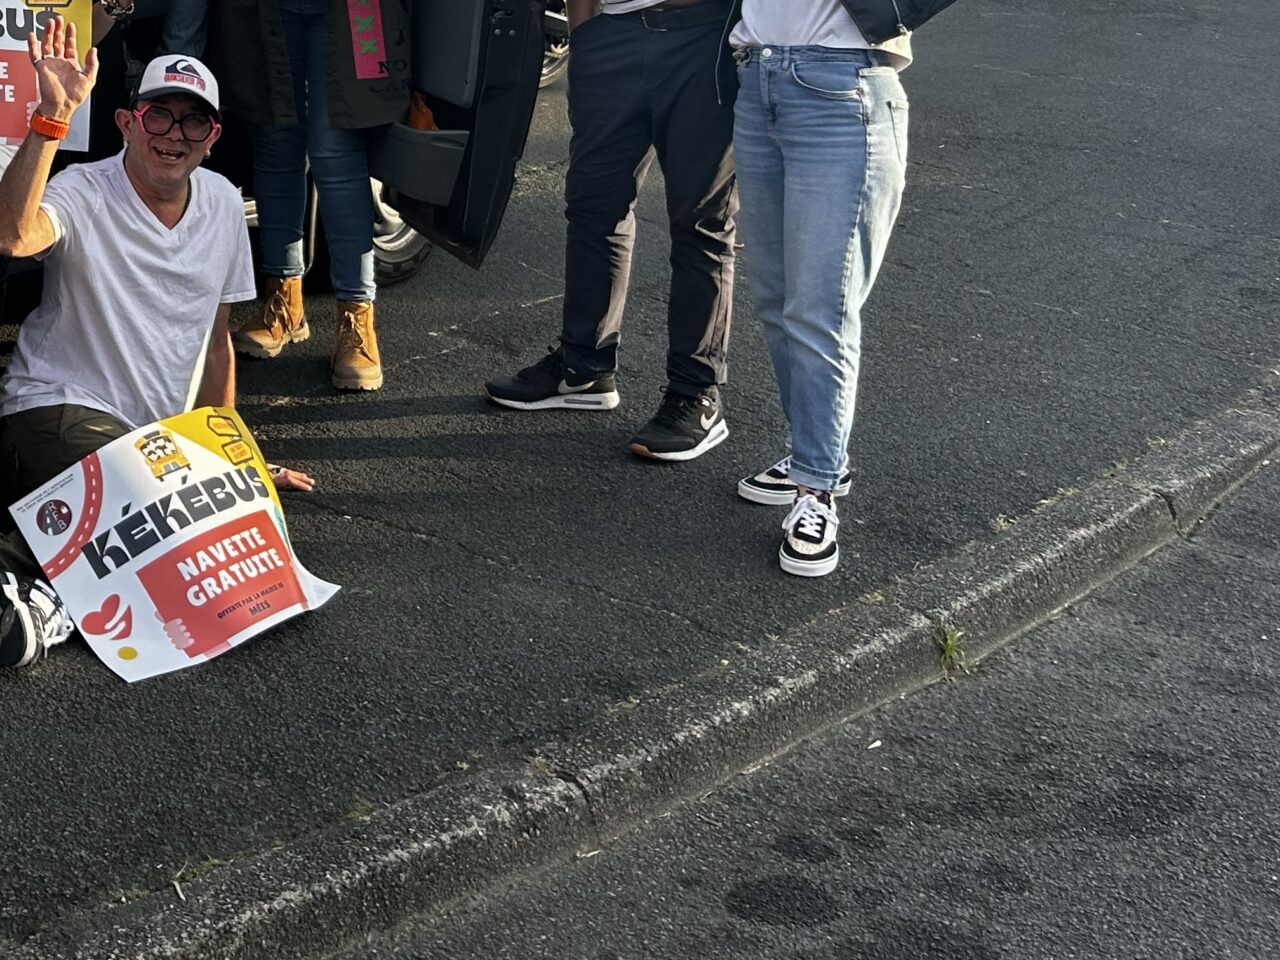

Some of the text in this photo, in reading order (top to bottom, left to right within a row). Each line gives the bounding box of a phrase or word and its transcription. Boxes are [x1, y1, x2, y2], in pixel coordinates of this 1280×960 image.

[80, 473, 270, 580] KÉKÉBUS
[176, 527, 267, 582] NAVETTE
[186, 547, 284, 607] GRATUITE
[217, 601, 243, 619] OFFERTE
[242, 595, 254, 607] PAR
[249, 599, 271, 616] MÉES
